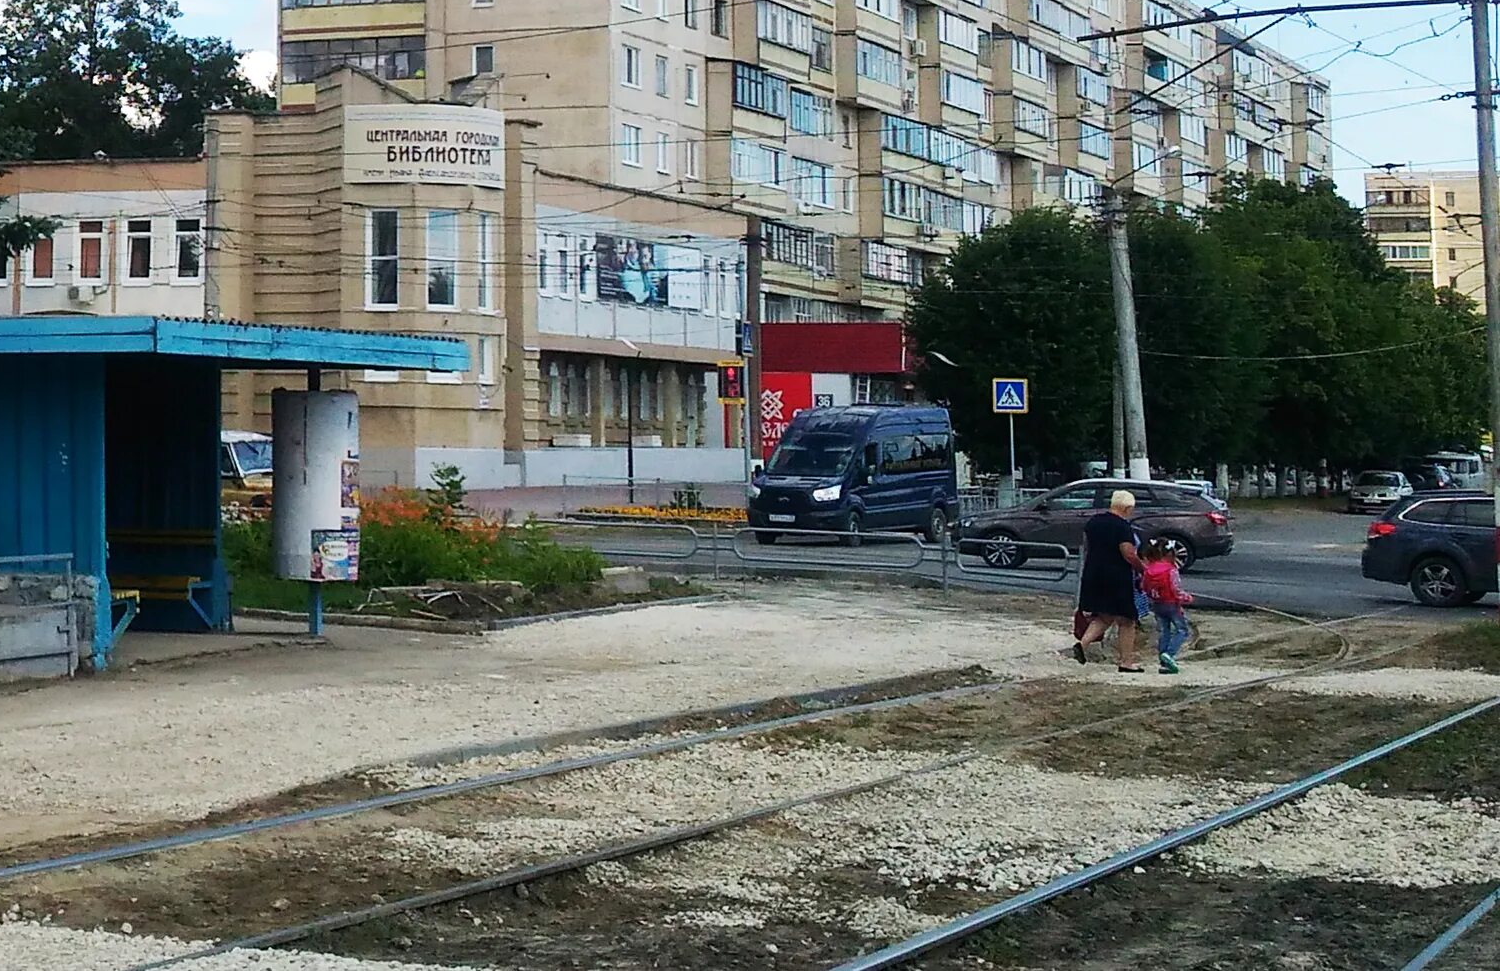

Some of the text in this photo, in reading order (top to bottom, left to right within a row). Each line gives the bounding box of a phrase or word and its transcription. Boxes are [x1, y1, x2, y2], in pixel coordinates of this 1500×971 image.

[366, 129, 448, 143] ЦЕНТРАЛЬНАЯ
[386, 146, 492, 166] БИБЛИОТЕКА
[817, 395, 831, 407] 36
